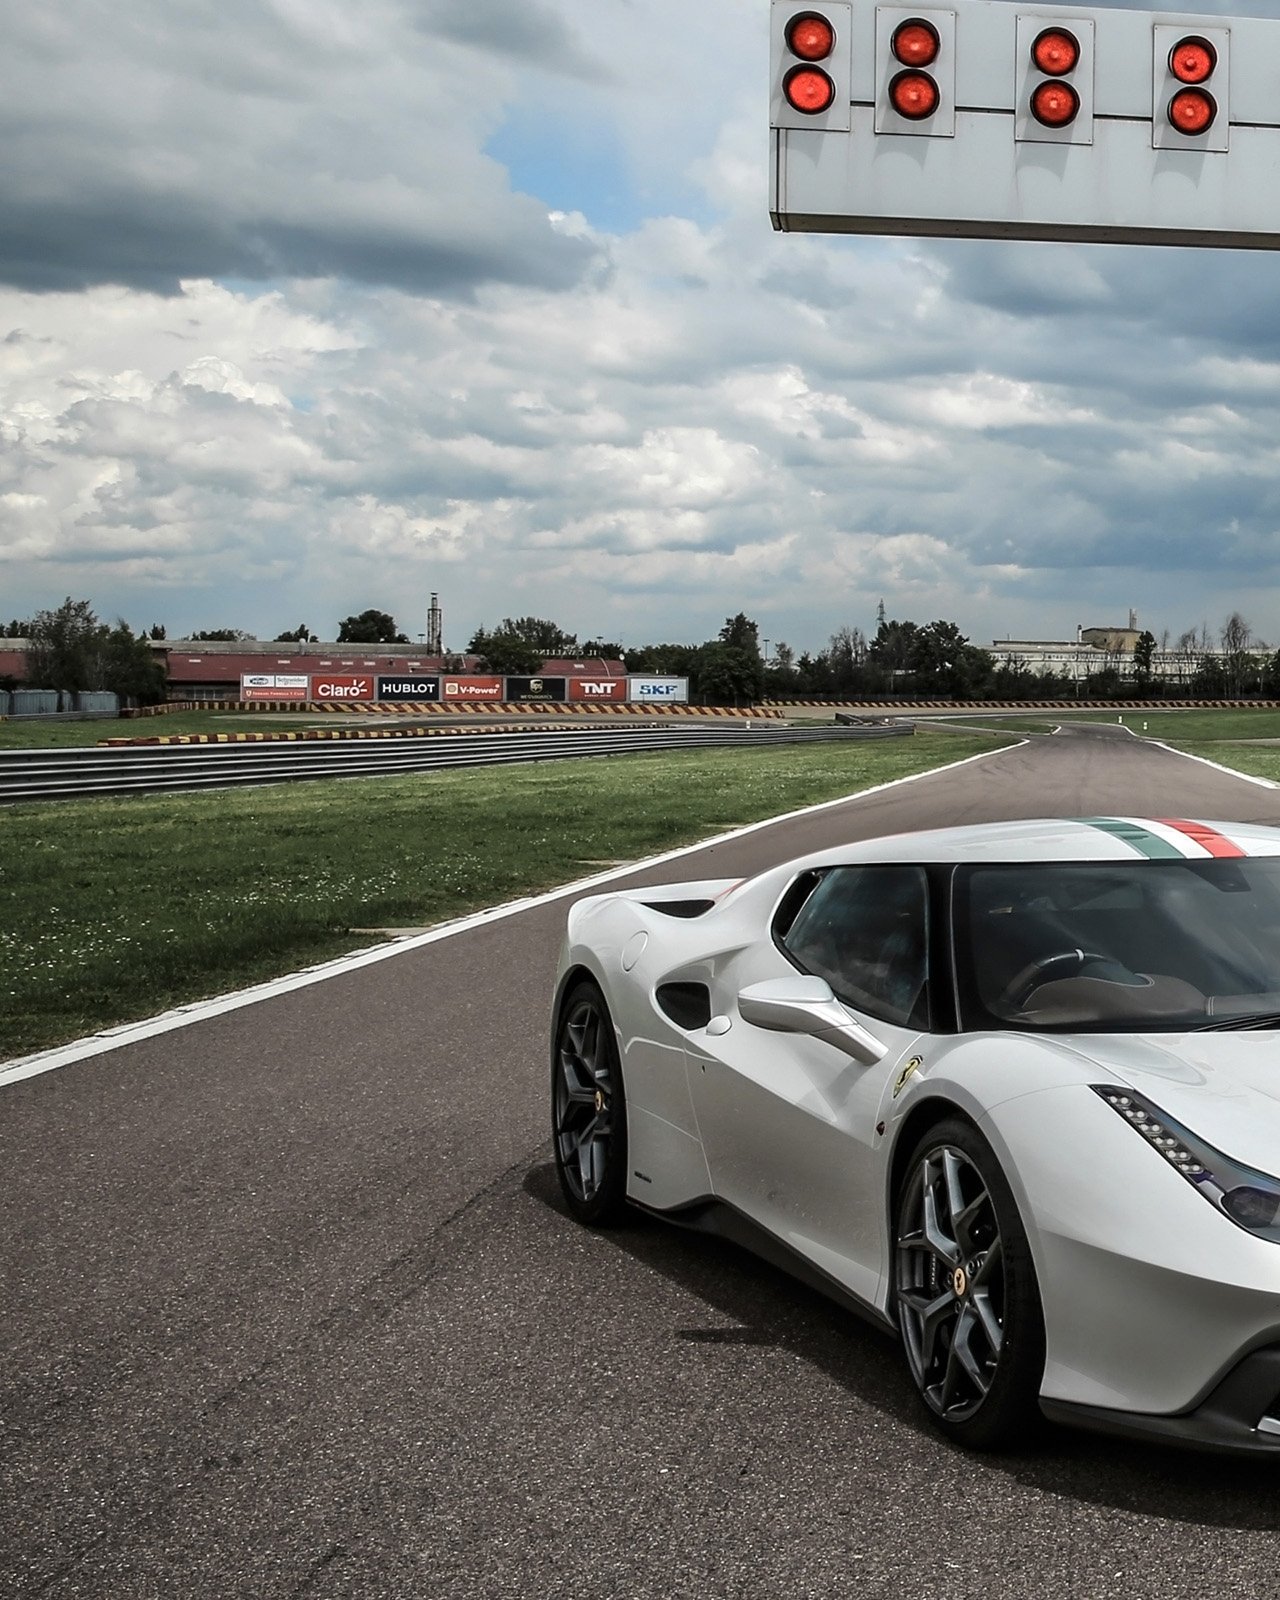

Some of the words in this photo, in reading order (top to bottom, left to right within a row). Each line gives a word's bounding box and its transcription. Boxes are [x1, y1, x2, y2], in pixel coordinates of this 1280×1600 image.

[318, 683, 361, 697] Claro
[382, 683, 436, 693] HUBLOT
[460, 685, 498, 694] V-Power
[580, 682, 617, 694] TNT
[639, 685, 678, 695] SKF
